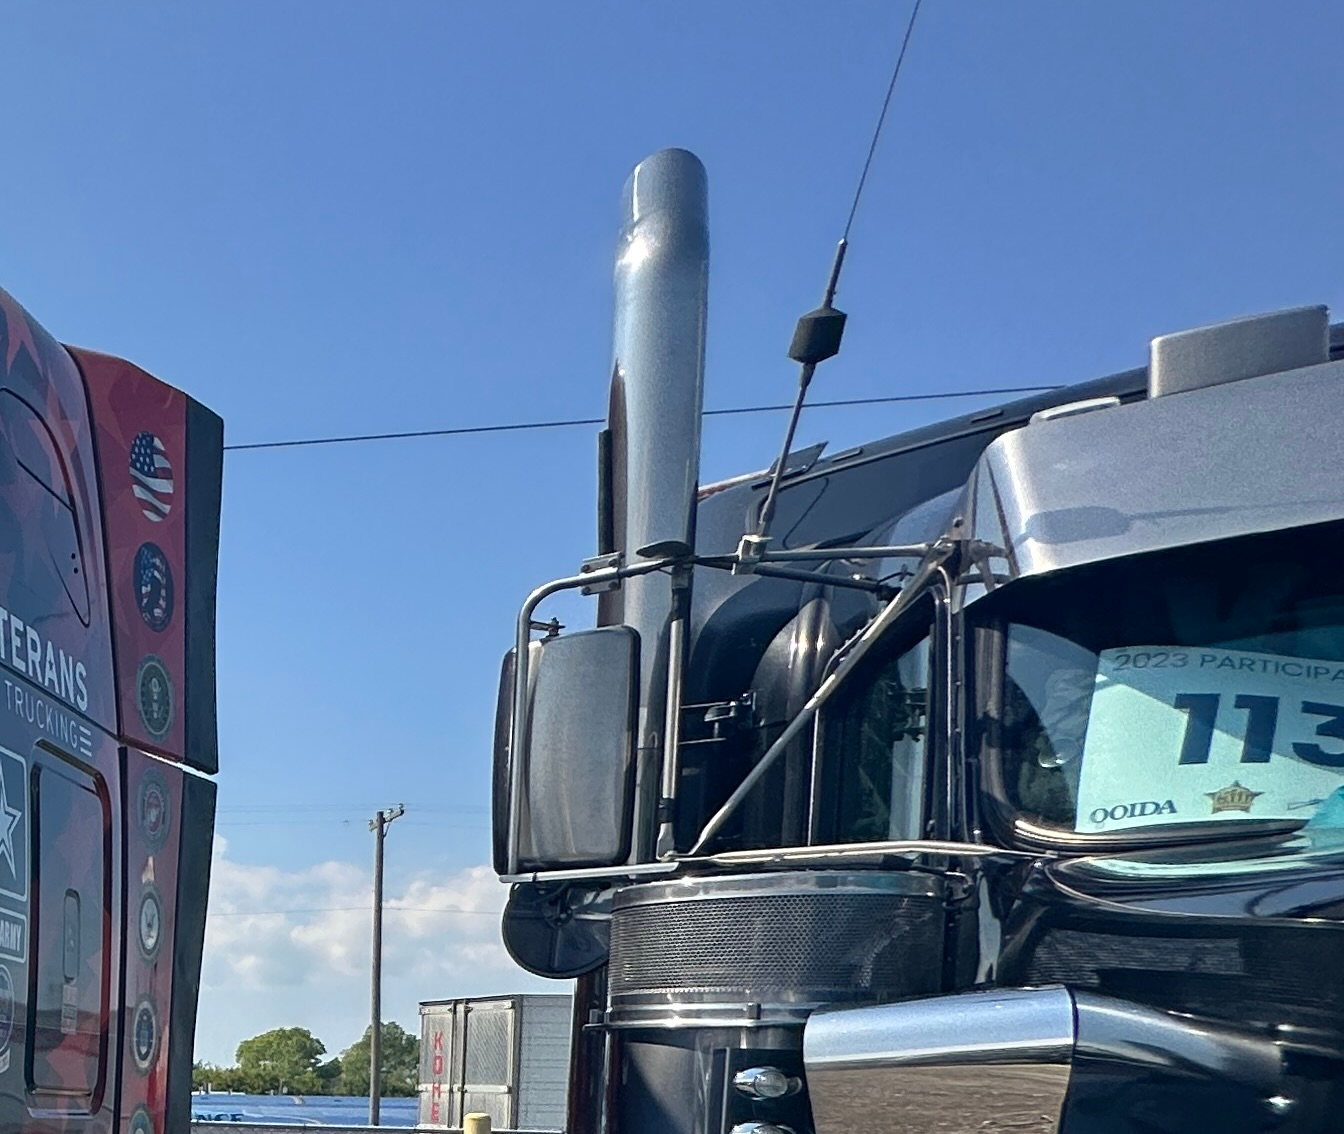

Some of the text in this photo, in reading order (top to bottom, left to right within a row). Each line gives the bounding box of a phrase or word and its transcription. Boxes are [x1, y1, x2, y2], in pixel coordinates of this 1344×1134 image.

[1112, 652, 1189, 671] 2023
[4, 680, 78, 749] TRUCKING
[1174, 692, 1344, 768] 113
[1090, 799, 1179, 825] OOIDA
